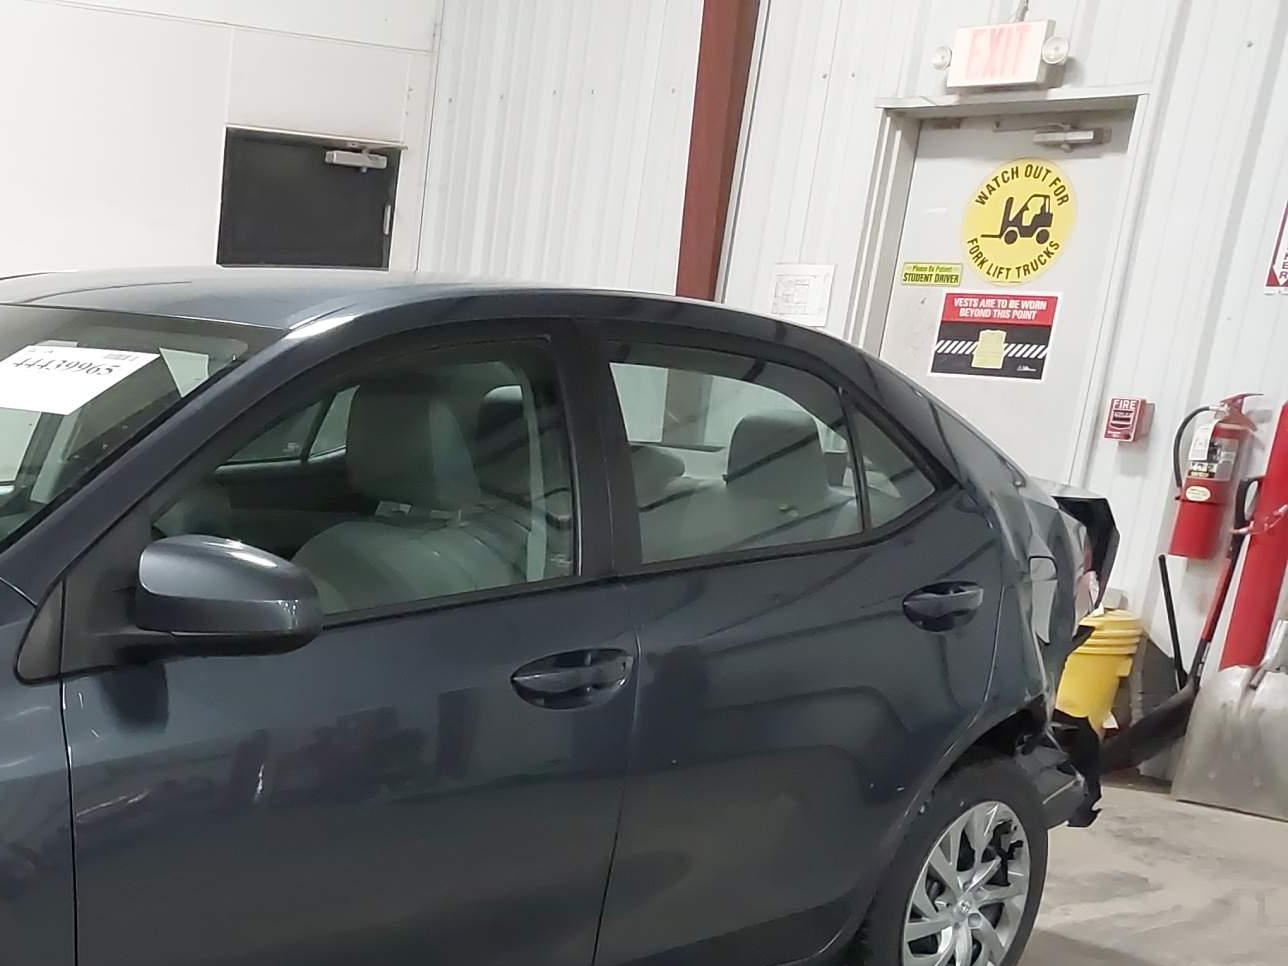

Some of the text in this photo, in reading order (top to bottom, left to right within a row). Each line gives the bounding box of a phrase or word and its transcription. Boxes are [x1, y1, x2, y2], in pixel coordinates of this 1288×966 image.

[965, 23, 1031, 80] EXIT
[975, 164, 1070, 206] WATCH OUT FOR
[967, 237, 1060, 280] FORK LIFT TRUCKS
[903, 272, 959, 283] STUDENT DRIVER
[954, 297, 1047, 311] VESTS ARE TO BE WORN
[959, 308, 1037, 320] BEYOND THIS POINT
[13, 357, 121, 376] 44439965
[1112, 399, 1136, 410] FIRE
